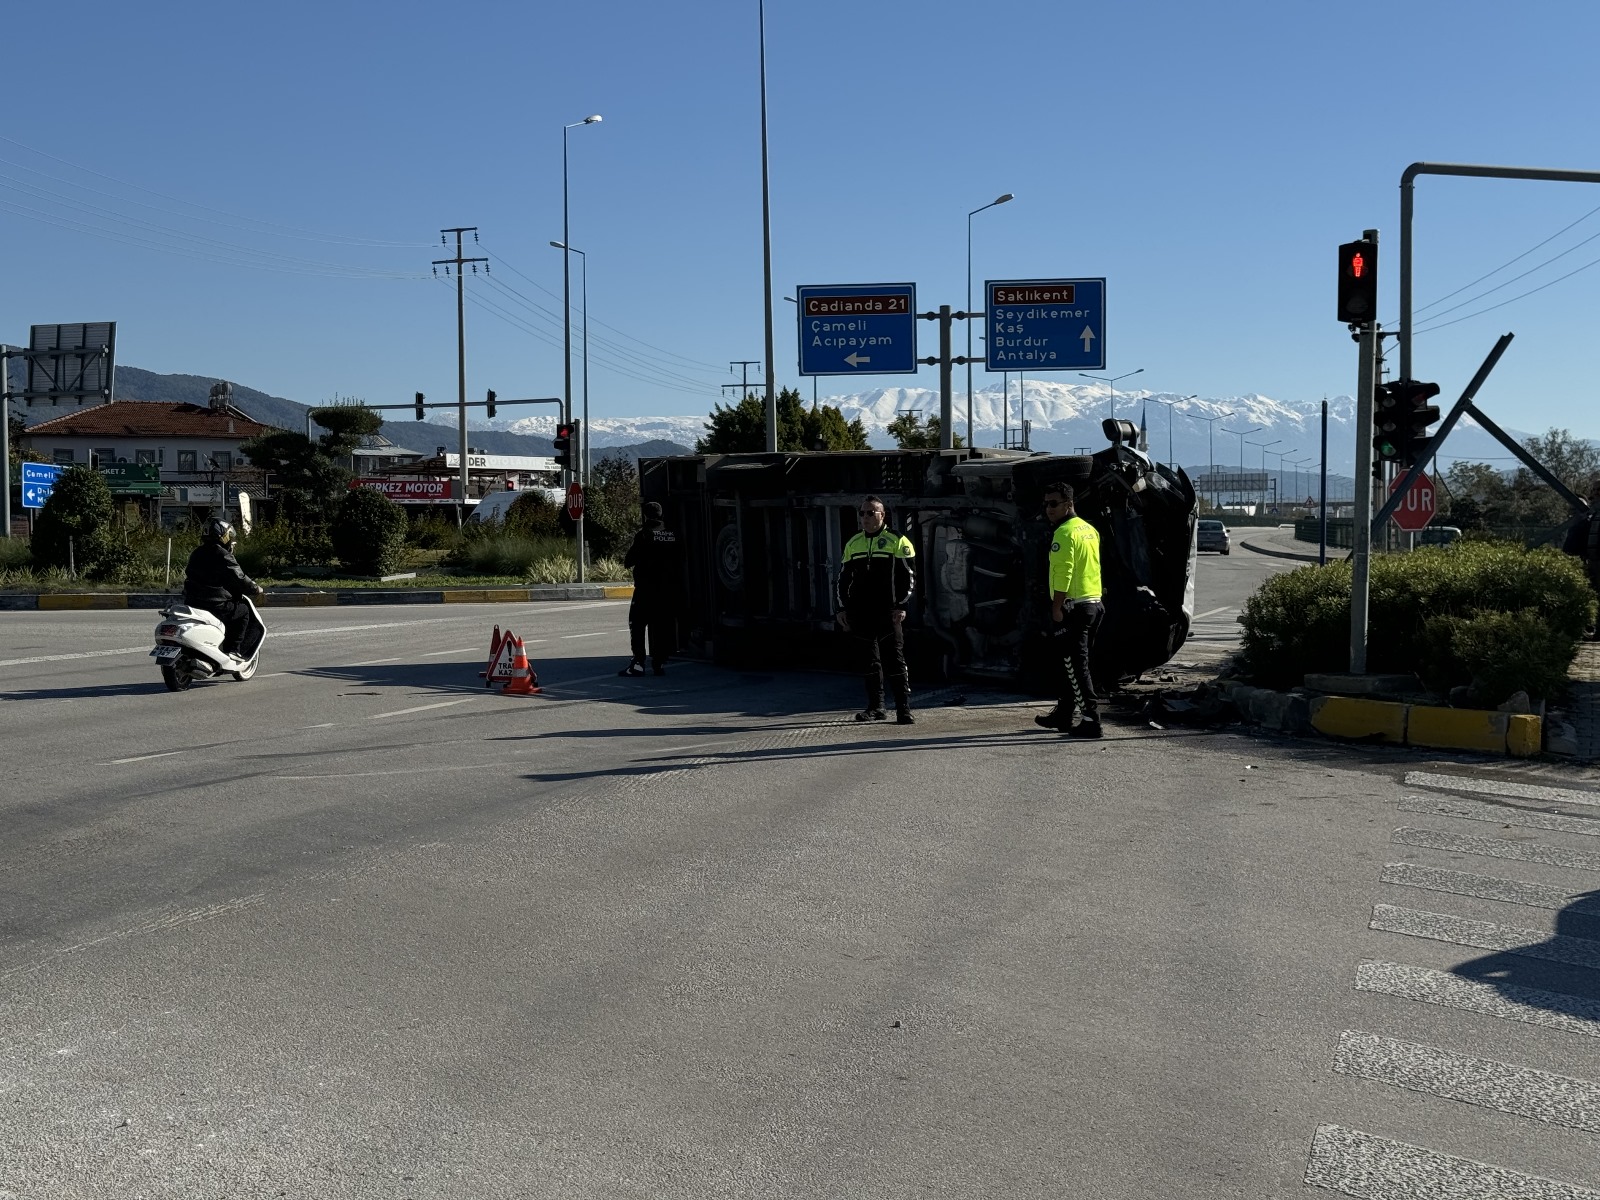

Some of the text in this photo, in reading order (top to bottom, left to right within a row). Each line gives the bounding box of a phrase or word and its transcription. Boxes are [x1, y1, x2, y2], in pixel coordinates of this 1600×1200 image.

[997, 290, 1068, 302] Saklıkent
[809, 299, 906, 312] Cadianda 21
[995, 308, 1090, 322] Seydikemer
[811, 320, 867, 334] Çameli
[995, 322, 1024, 334] Kaş
[812, 335, 892, 349] Acıpayam
[996, 336, 1048, 348] Burdur
[997, 350, 1058, 363] Antalya
[469, 457, 486, 467] DER
[405, 482, 444, 493] MOTOR
[568, 493, 583, 509] DUR
[498, 662, 513, 670] TRA
